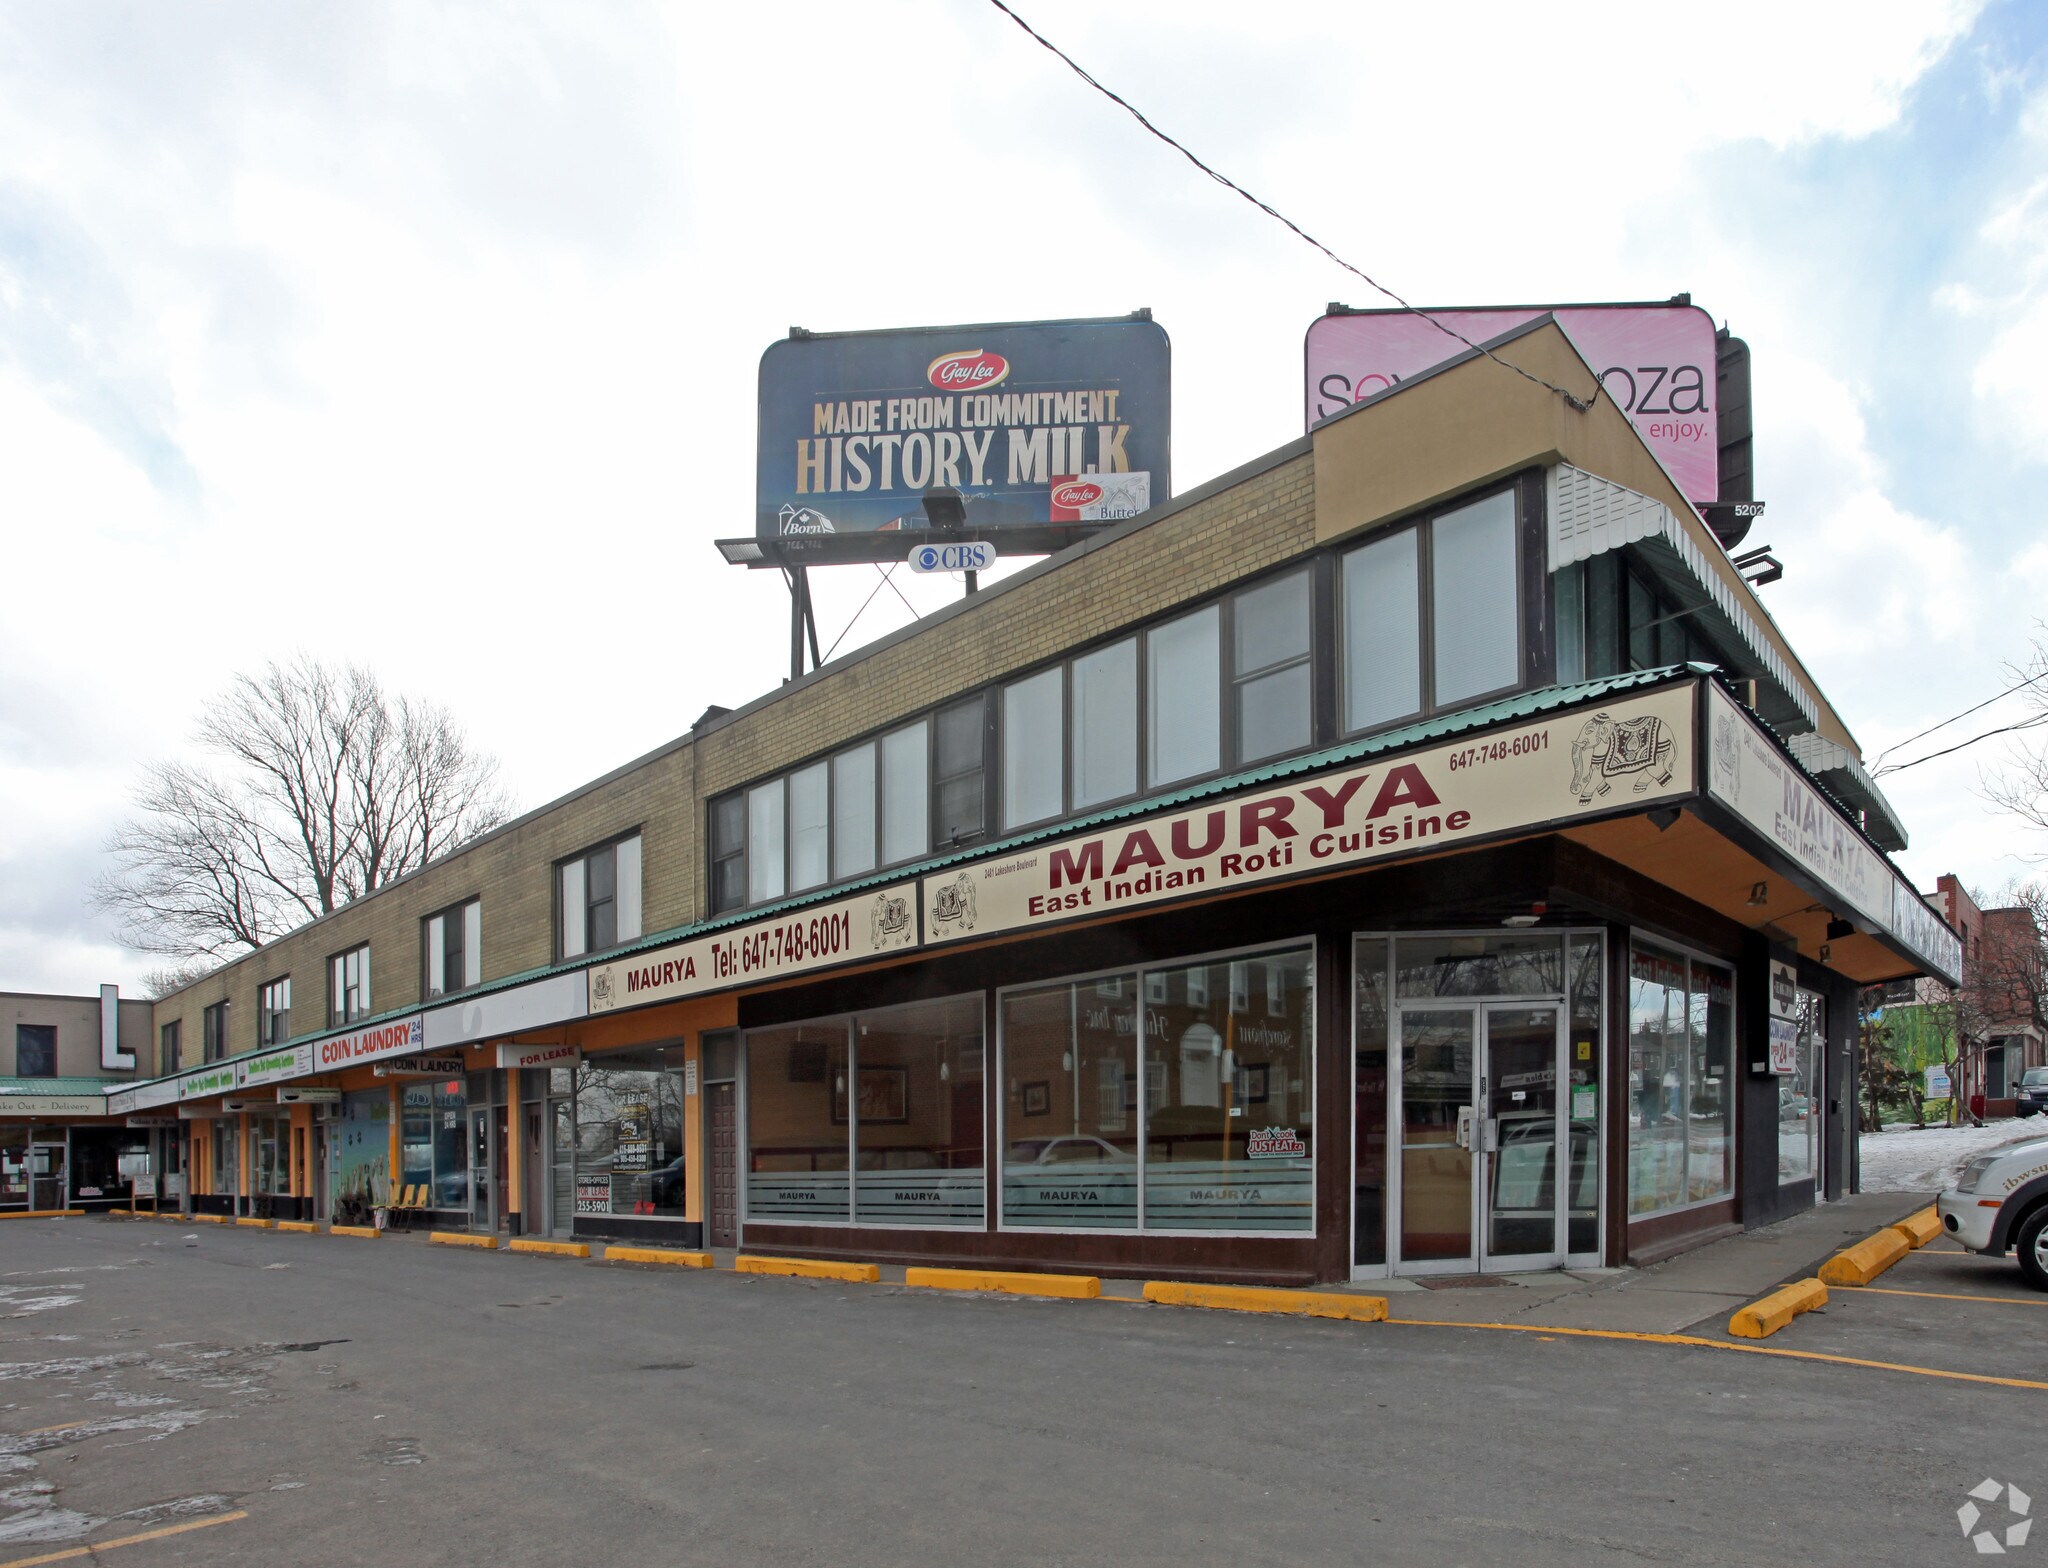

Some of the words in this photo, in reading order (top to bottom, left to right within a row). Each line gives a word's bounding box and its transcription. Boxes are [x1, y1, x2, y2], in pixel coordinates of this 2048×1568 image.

[941, 362, 972, 384] Gay
[970, 361, 994, 380] Lea
[814, 400, 881, 435] MADE
[887, 396, 953, 431] FROM
[960, 390, 1121, 428] COMMITMENT.
[1650, 420, 1708, 442] enjoy.
[796, 430, 993, 494] HISTORY.
[1061, 489, 1081, 502] Gay
[1080, 489, 1094, 501] Lea
[1101, 507, 1139, 519] Butter
[1734, 504, 1765, 516] 5202
[789, 523, 822, 534] Born
[942, 545, 986, 568] CBS
[1449, 730, 1548, 771] 647-748-6001
[1049, 763, 1441, 889] MAURYA
[1783, 769, 1865, 884] MAURYA
[1774, 811, 1797, 851] East
[1799, 833, 1826, 874] Indian
[1828, 859, 1844, 888] Roti
[995, 864, 1016, 876] Lakeshore
[1017, 856, 1038, 871] Boulevard
[1029, 885, 1092, 917] East
[1104, 867, 1205, 902] Indian
[1220, 842, 1293, 878] Roti
[1309, 810, 1472, 859] Cuisine
[627, 956, 696, 993] MAURYA
[711, 940, 739, 979] Tel:
[743, 910, 850, 973] 647-748-6001
[411, 1020, 421, 1033] 24
[322, 1038, 351, 1064] COIN
[354, 1022, 411, 1056] LAUNDRY
[411, 1033, 422, 1044] HRS
[520, 1054, 541, 1066] FOR
[543, 1047, 574, 1061] LEASE
[394, 1059, 417, 1071] COIN
[421, 1060, 463, 1073] LAUNDRY
[18, 1101, 36, 1110] Out
[51, 1101, 90, 1112] Delivery
[1250, 1141, 1274, 1152] JUST
[576, 1186, 588, 1196] FOR
[592, 1186, 609, 1197] LEASE
[779, 1192, 816, 1200] MAURYA
[895, 1192, 941, 1201] MAURYA
[1040, 1191, 1098, 1200] MAURYA
[1190, 1189, 1262, 1200] MAURYA
[577, 1200, 609, 1212] 255-5901
